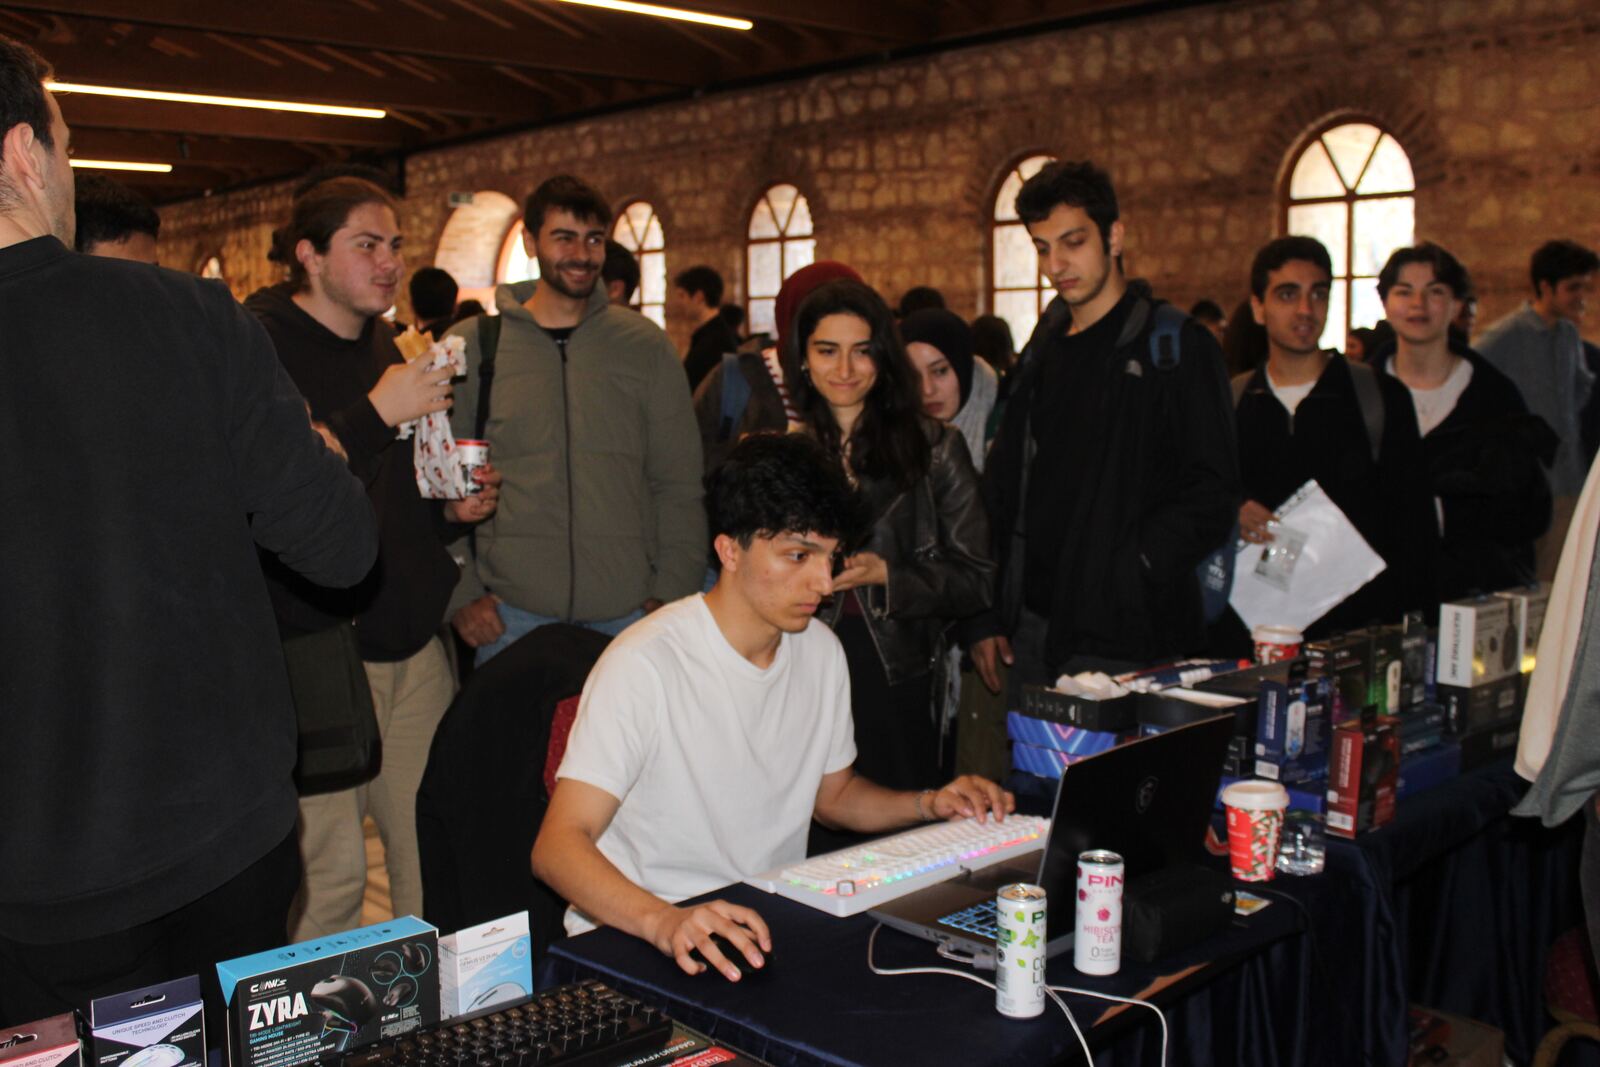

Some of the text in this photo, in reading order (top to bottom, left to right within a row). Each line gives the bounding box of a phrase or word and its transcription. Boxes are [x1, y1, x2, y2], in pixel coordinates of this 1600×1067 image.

[248, 992, 308, 1031] ZYRA
[112, 1012, 186, 1035] UNIQUE SPEED AND CLUTCH
[132, 1022, 168, 1035] TECHNOLOGY
